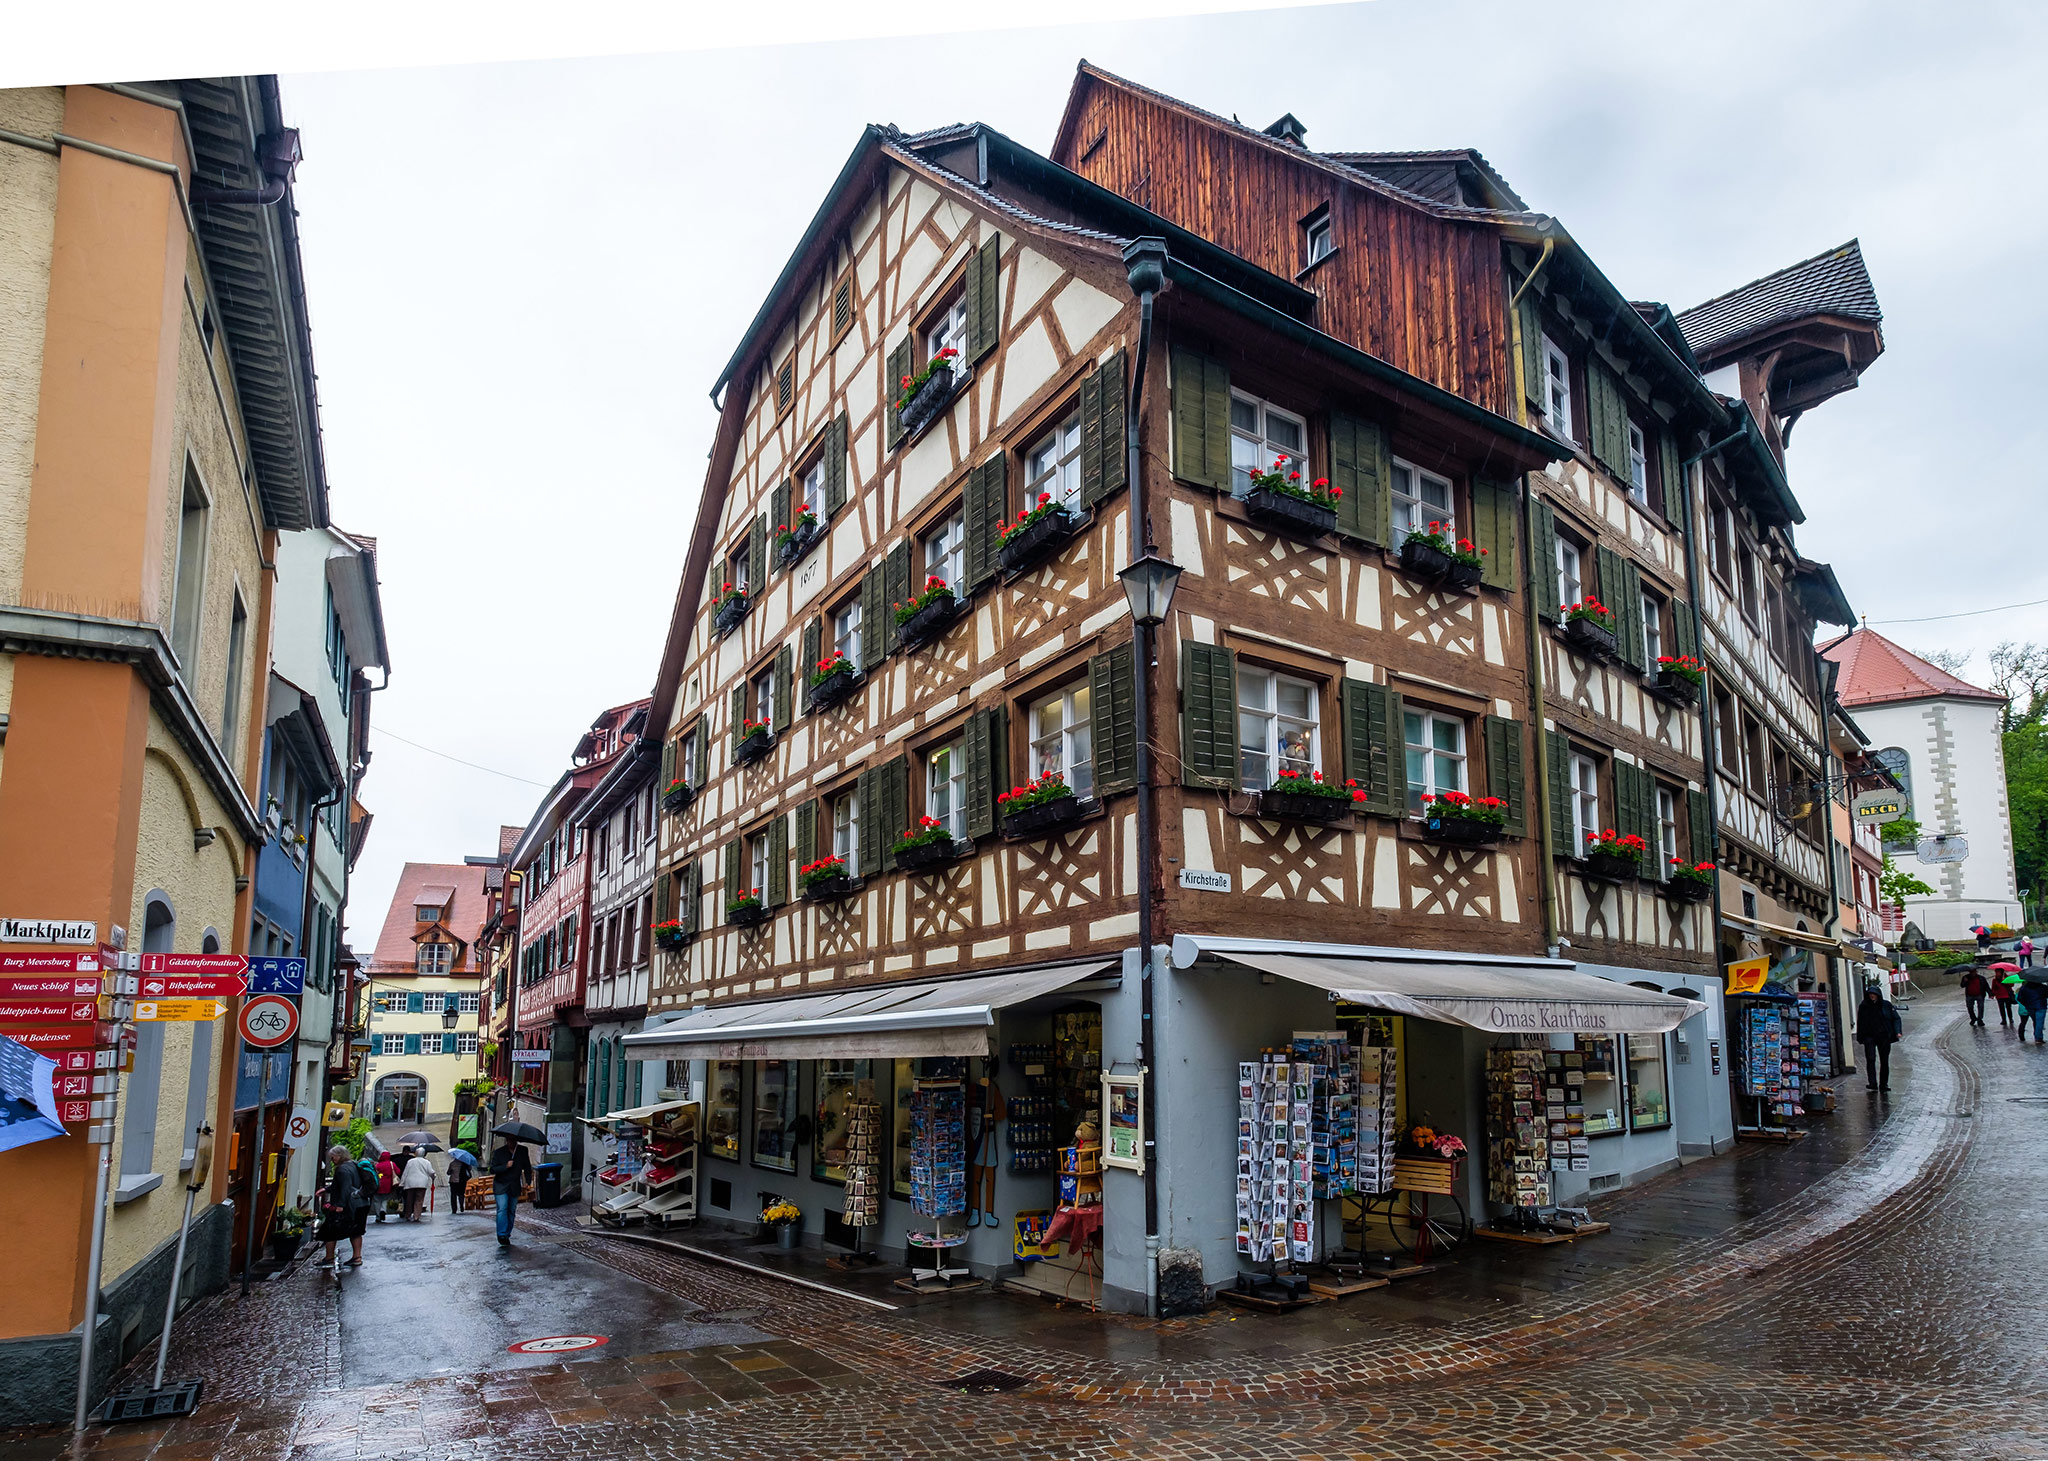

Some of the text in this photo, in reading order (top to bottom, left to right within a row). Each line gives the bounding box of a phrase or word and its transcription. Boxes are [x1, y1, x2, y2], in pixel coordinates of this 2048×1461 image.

[800, 559, 818, 588] 1677
[1861, 804, 1897, 816] KECK
[1185, 872, 1227, 888] Kirchstraße
[4, 921, 92, 942] Marktplatz
[3, 957, 71, 968] Burg Meersburg
[168, 957, 240, 968] Gästeinformation
[11, 981, 70, 992] Neues Schloß
[168, 981, 216, 990] Bibelgalerie
[1491, 1006, 1606, 1029] Omas Kaufhaus
[29, 1033, 71, 1042] Bodensee
